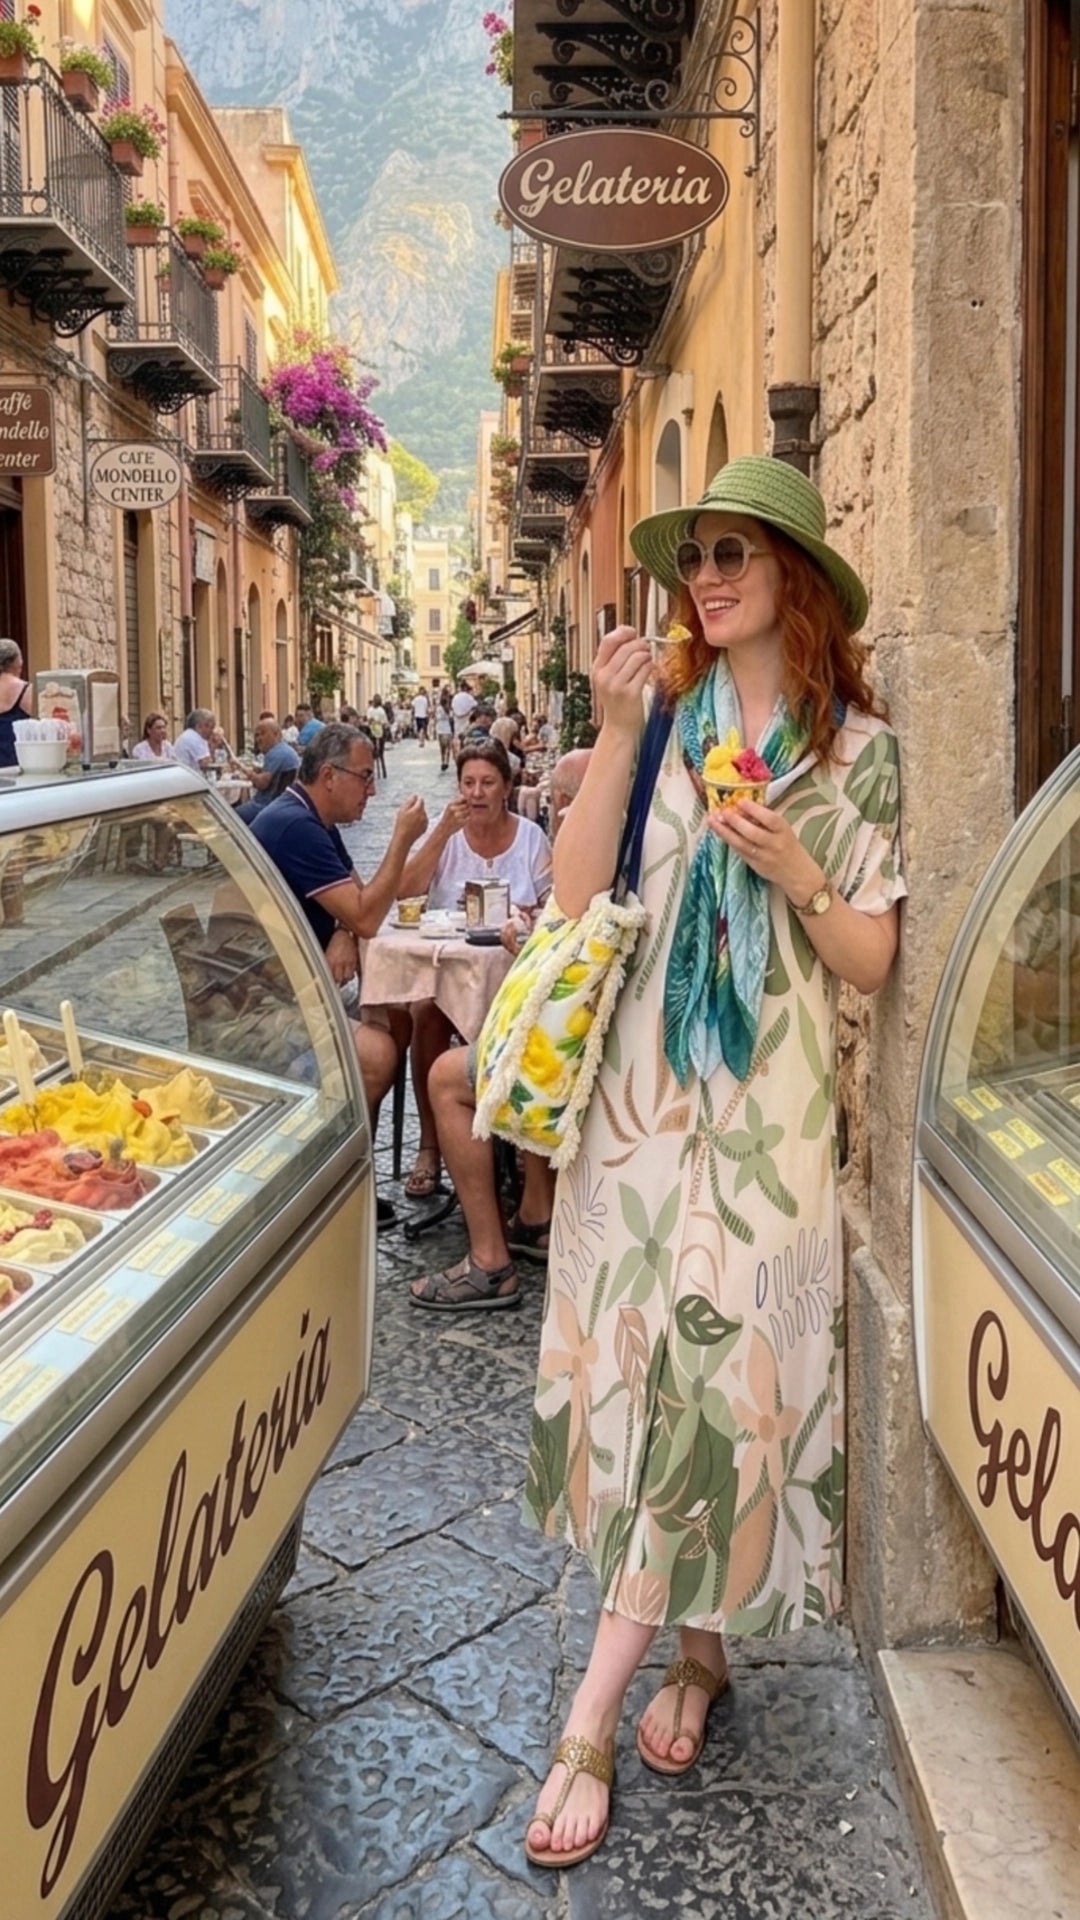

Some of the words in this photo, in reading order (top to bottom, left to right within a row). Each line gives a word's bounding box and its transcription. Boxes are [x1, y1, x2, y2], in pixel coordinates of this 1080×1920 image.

[518, 158, 713, 218] Gelateria
[110, 487, 164, 502] CENTER
[26, 1308, 332, 1898] Gelateria
